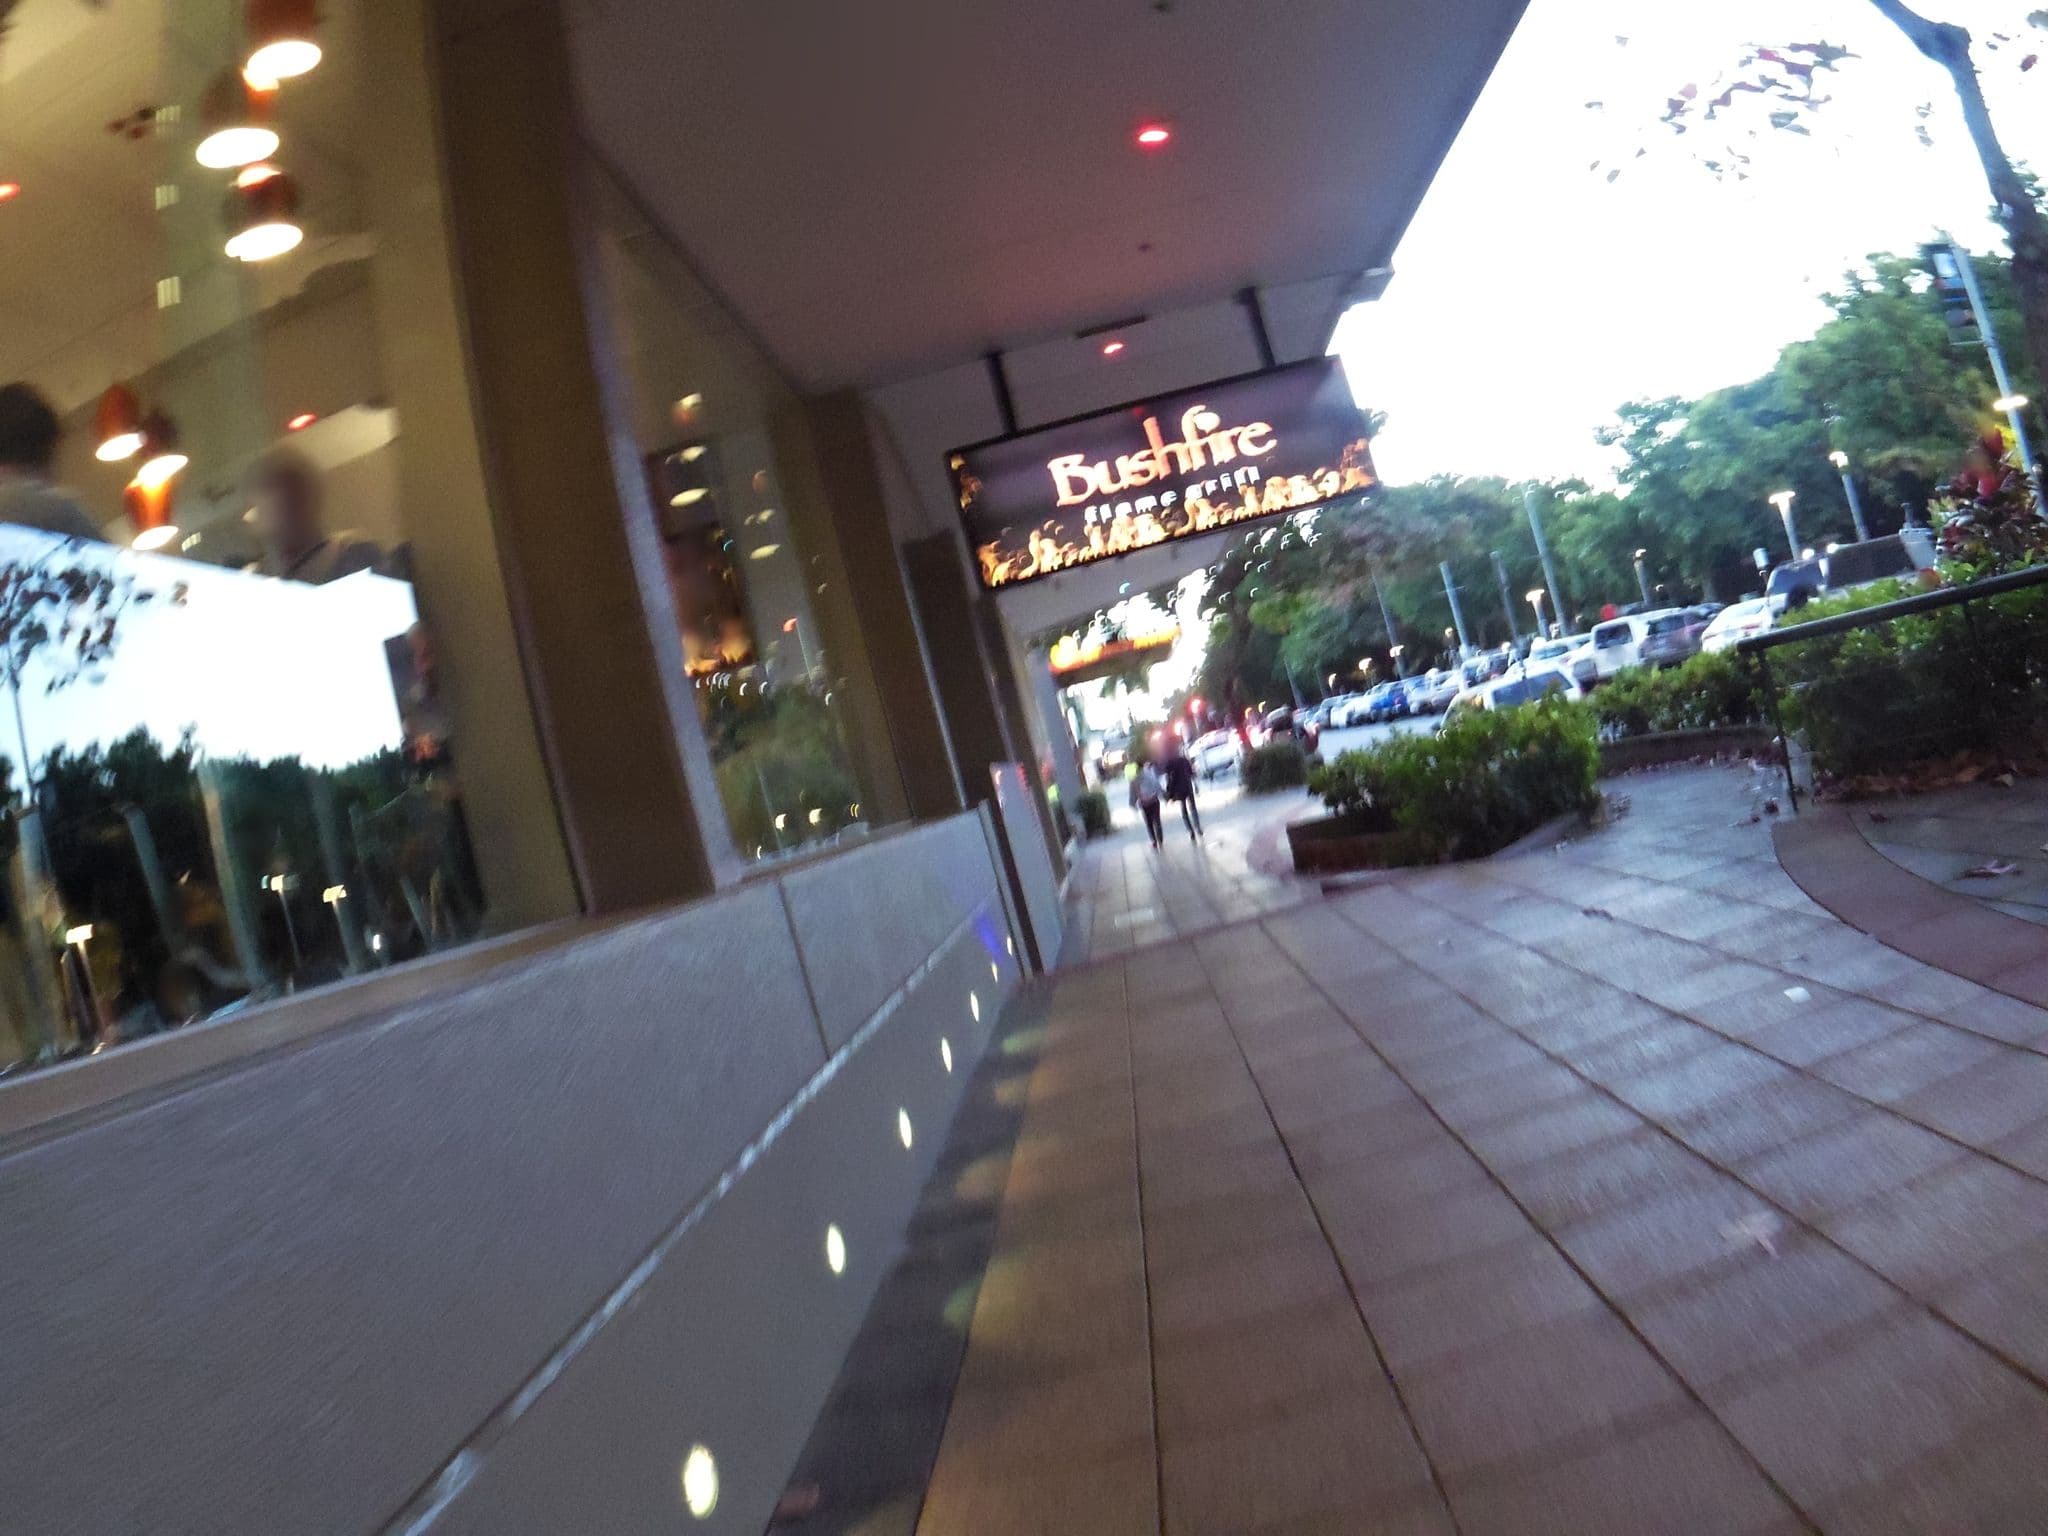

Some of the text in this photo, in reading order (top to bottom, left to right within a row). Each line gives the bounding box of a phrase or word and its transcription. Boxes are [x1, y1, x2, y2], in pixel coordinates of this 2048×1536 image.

[1046, 404, 1279, 507] Bushfire
[1084, 466, 1261, 524] flame grill
